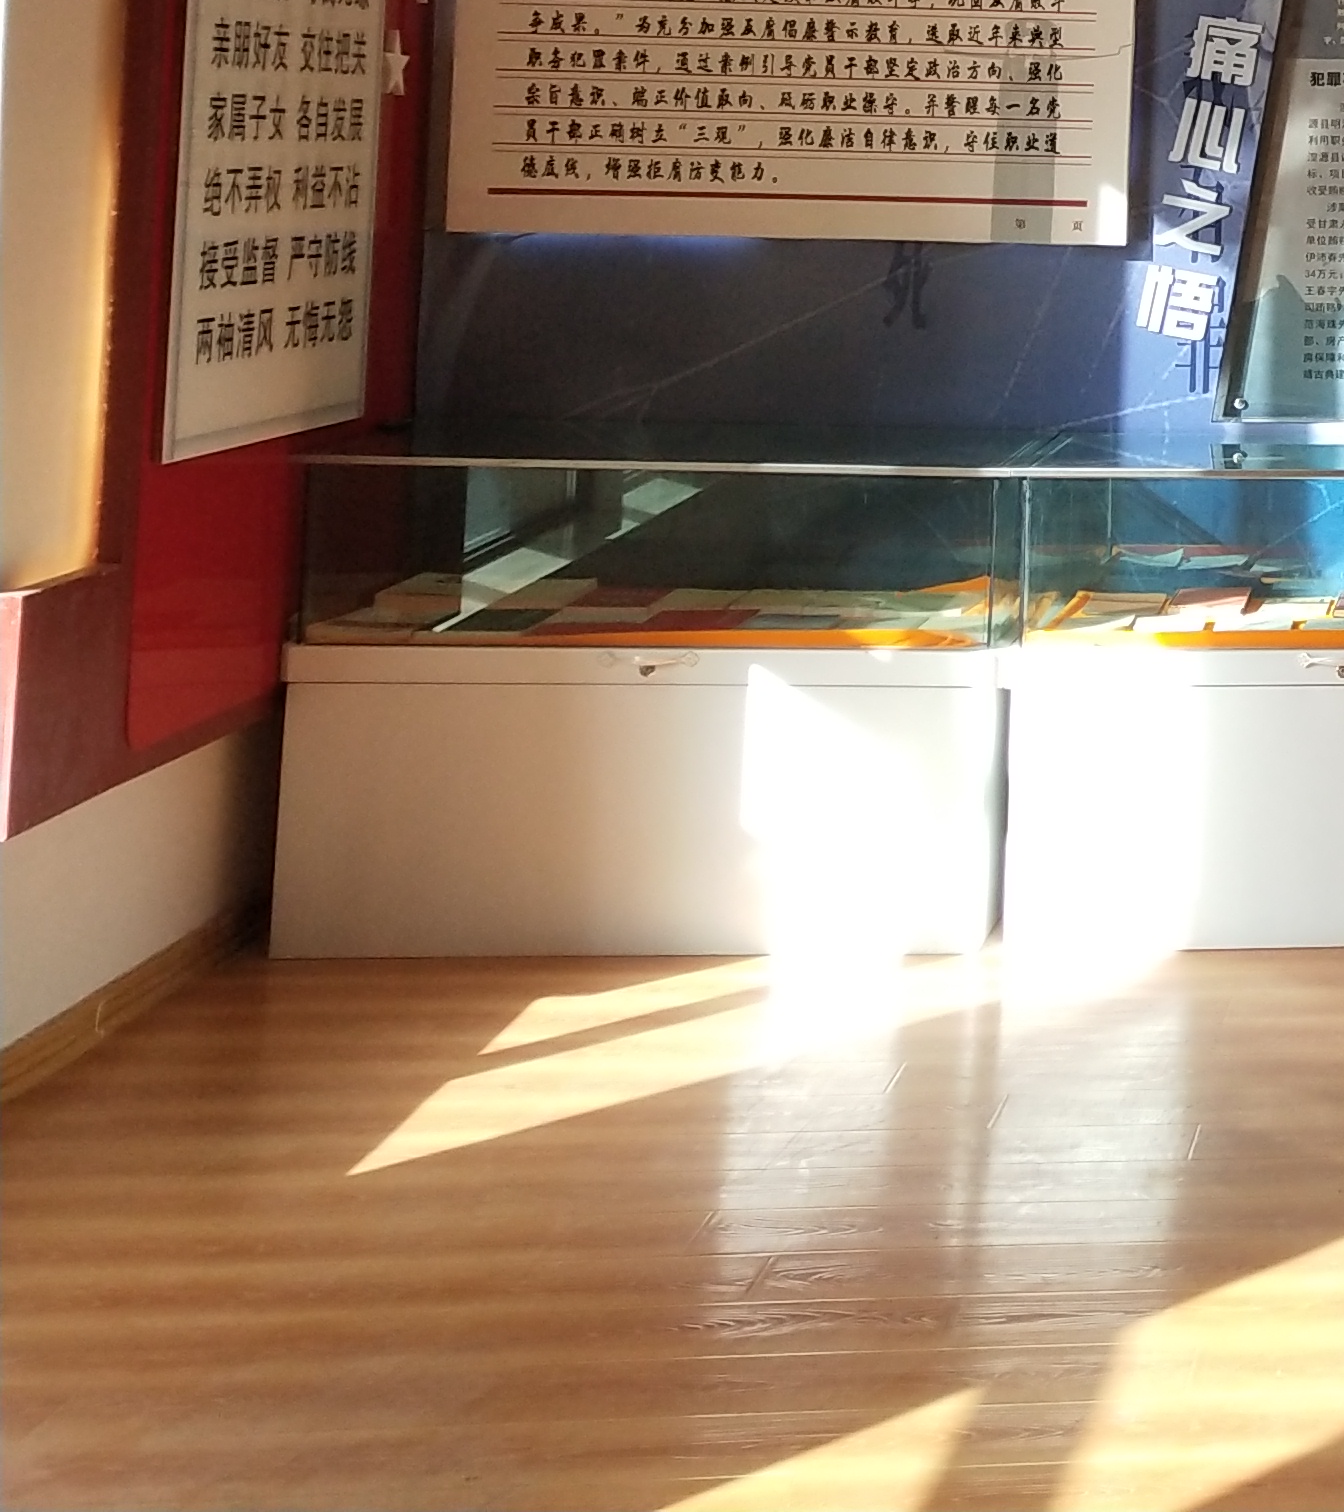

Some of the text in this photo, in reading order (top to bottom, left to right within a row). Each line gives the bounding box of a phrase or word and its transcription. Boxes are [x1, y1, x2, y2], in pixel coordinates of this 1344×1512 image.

[211, 17, 290, 71] 亲朋好友
[207, 92, 363, 141] 家属子女 各自发展
[203, 164, 360, 216] 绝不弄权 利益不沾
[520, 154, 780, 185] 德底线，增强拒腐防变能力。
[1135, 14, 1265, 342] 痛心之悟
[199, 231, 356, 290] 接受监督 严守防线
[196, 308, 274, 365] 两袖清风
